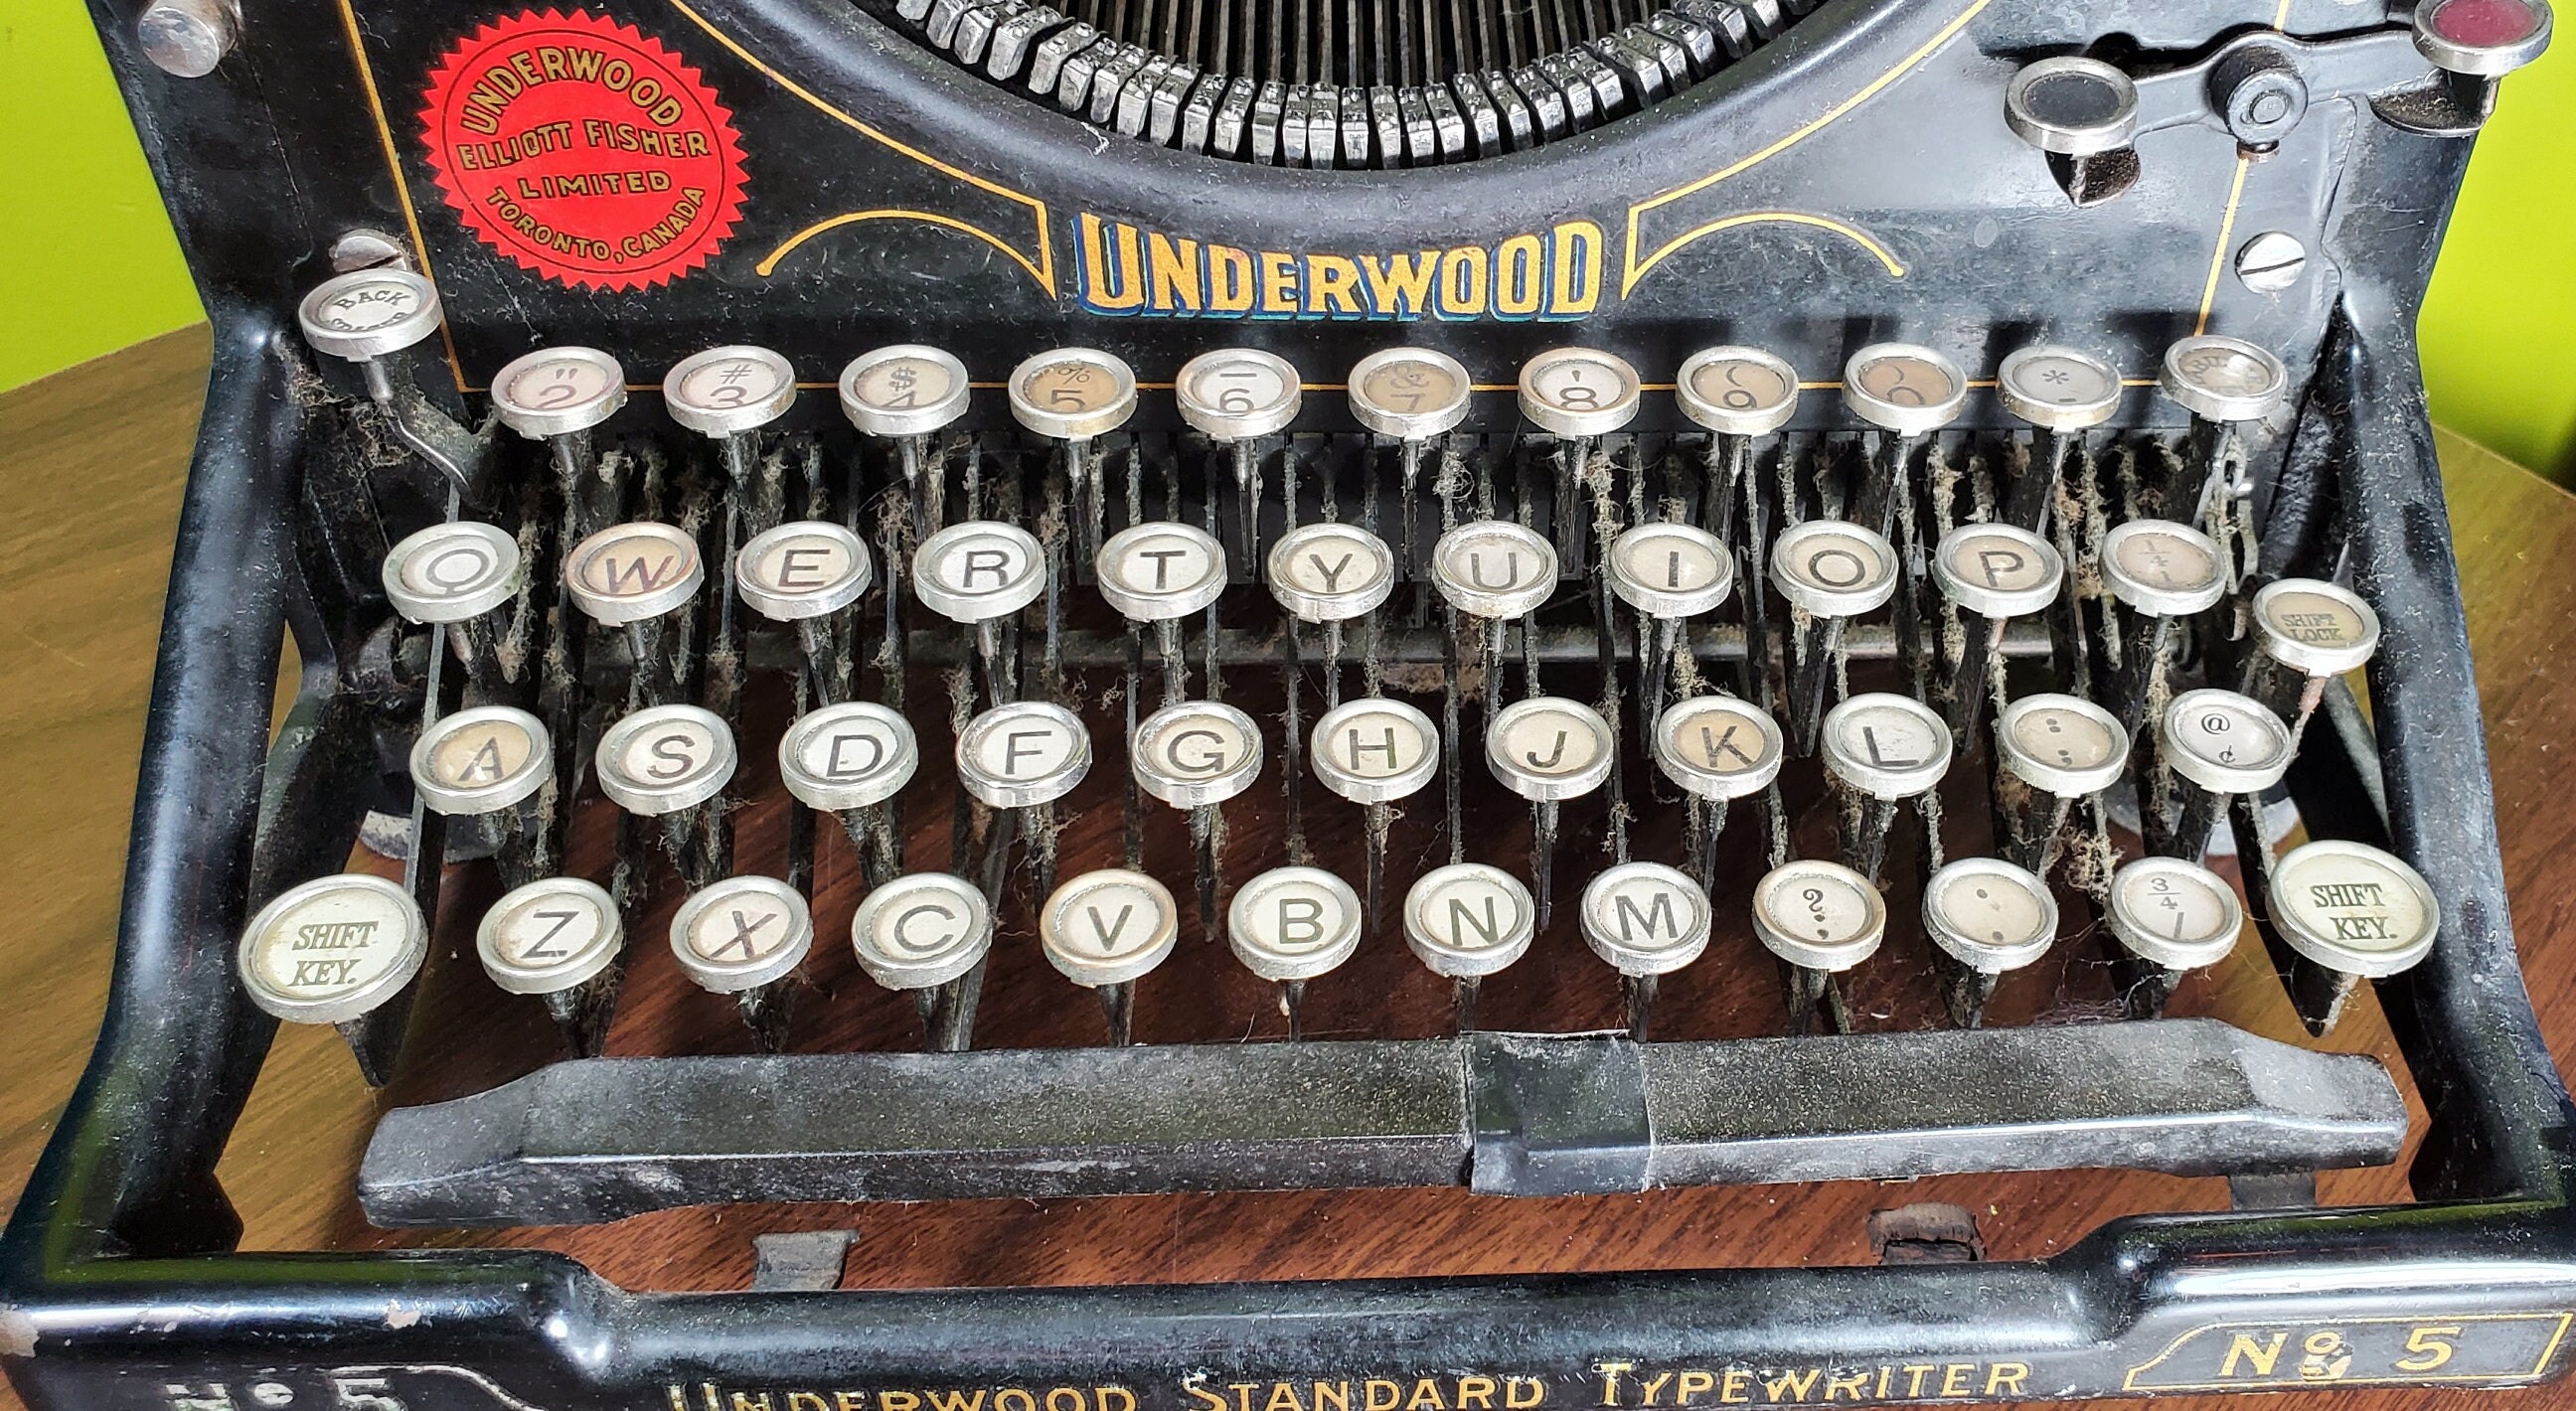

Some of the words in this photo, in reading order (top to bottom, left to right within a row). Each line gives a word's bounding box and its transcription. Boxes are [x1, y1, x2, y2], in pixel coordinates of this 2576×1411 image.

[461, 47, 684, 136] UNDERWOOD
[457, 122, 573, 171] ELLIOTT
[583, 119, 711, 159] FISHER
[518, 171, 672, 199] LIMITED
[1070, 212, 1603, 323] UNDERWOOD
[333, 290, 410, 310] BACK
[720, 364, 752, 385] #
[888, 367, 916, 392] $
[1056, 366, 1091, 386] %
[1390, 364, 1430, 389] &
[538, 386, 576, 408] 2
[709, 386, 748, 409] 3
[1049, 389, 1085, 413] 5
[1218, 388, 1254, 413] 6
[1390, 392, 1426, 412] 7
[1558, 387, 1599, 409] 8
[1722, 391, 1757, 409] 9
[605, 554, 676, 594] W
[777, 549, 831, 587] E
[963, 549, 1012, 588] R
[1139, 549, 1187, 589] T
[1309, 552, 1354, 593] Y
[1471, 551, 1518, 589] U
[1667, 550, 1680, 588] I
[1808, 549, 1866, 588] O
[1979, 550, 2024, 589] P
[2281, 613, 2337, 628] SHIFT
[2290, 627, 2343, 643] LOCK
[2201, 713, 2231, 735] @
[457, 736, 505, 781] A
[646, 734, 698, 779] S
[825, 734, 884, 777] D
[1005, 730, 1052, 775] F
[1167, 729, 1225, 773] G
[1348, 726, 1397, 770] H
[1526, 730, 1568, 768] J
[1701, 725, 1753, 768] K
[1862, 726, 1920, 768] L
[2310, 882, 2383, 908] SHIFT
[291, 921, 379, 951] SHIFT
[521, 911, 579, 959] Z
[712, 910, 778, 959] X
[894, 904, 957, 953] C
[1087, 904, 1134, 952] V
[1279, 897, 1324, 945] B
[1448, 896, 1498, 946] N
[1615, 892, 1679, 942] M
[2330, 916, 2399, 941] KEY.
[287, 959, 358, 988] KEY.
[2394, 1327, 2462, 1371] 5
[1183, 1367, 1543, 1411] STANDARD
[1593, 1360, 2033, 1407] TYPEWRITER
